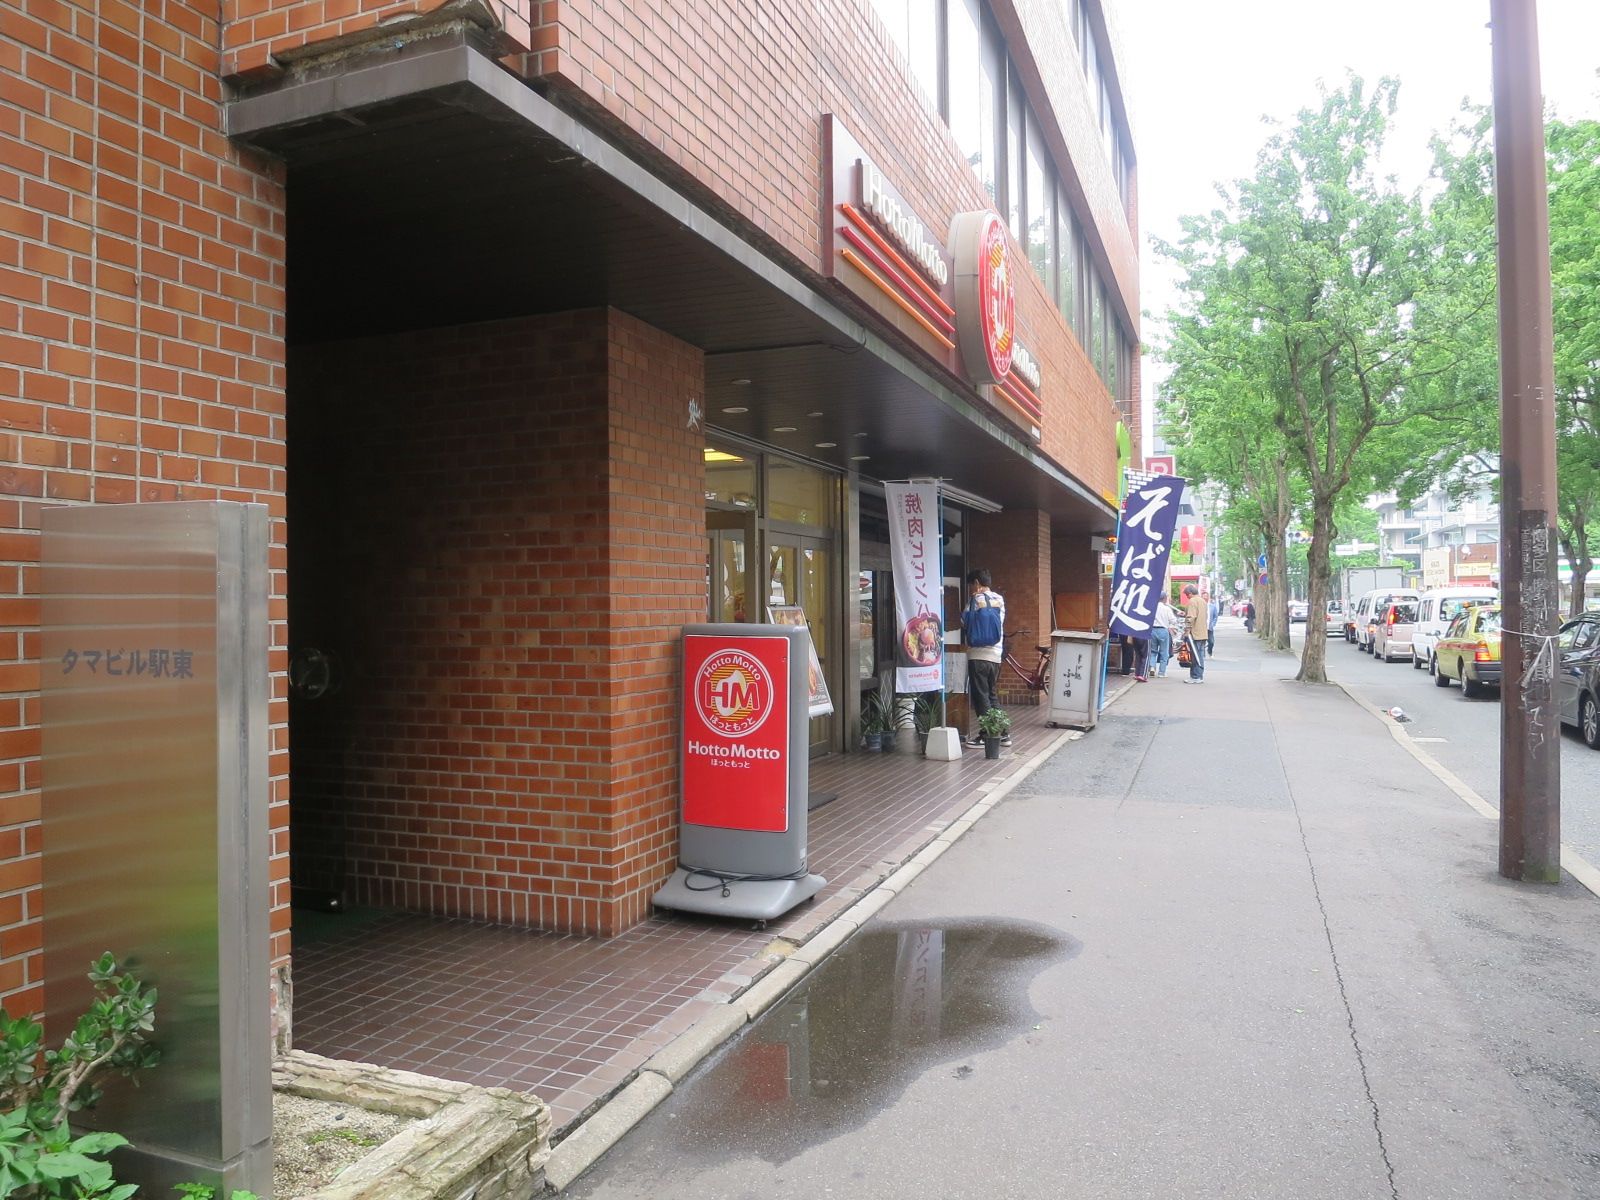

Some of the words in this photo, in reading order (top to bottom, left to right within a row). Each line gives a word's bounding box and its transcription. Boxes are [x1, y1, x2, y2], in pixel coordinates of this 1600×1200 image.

[1108, 486, 1173, 632] そば処
[61, 648, 194, 679] タマビル駅東
[709, 714, 756, 732] ほっともっと
[688, 739, 781, 761] HottoMotto
[710, 758, 751, 769] ほっともっと
